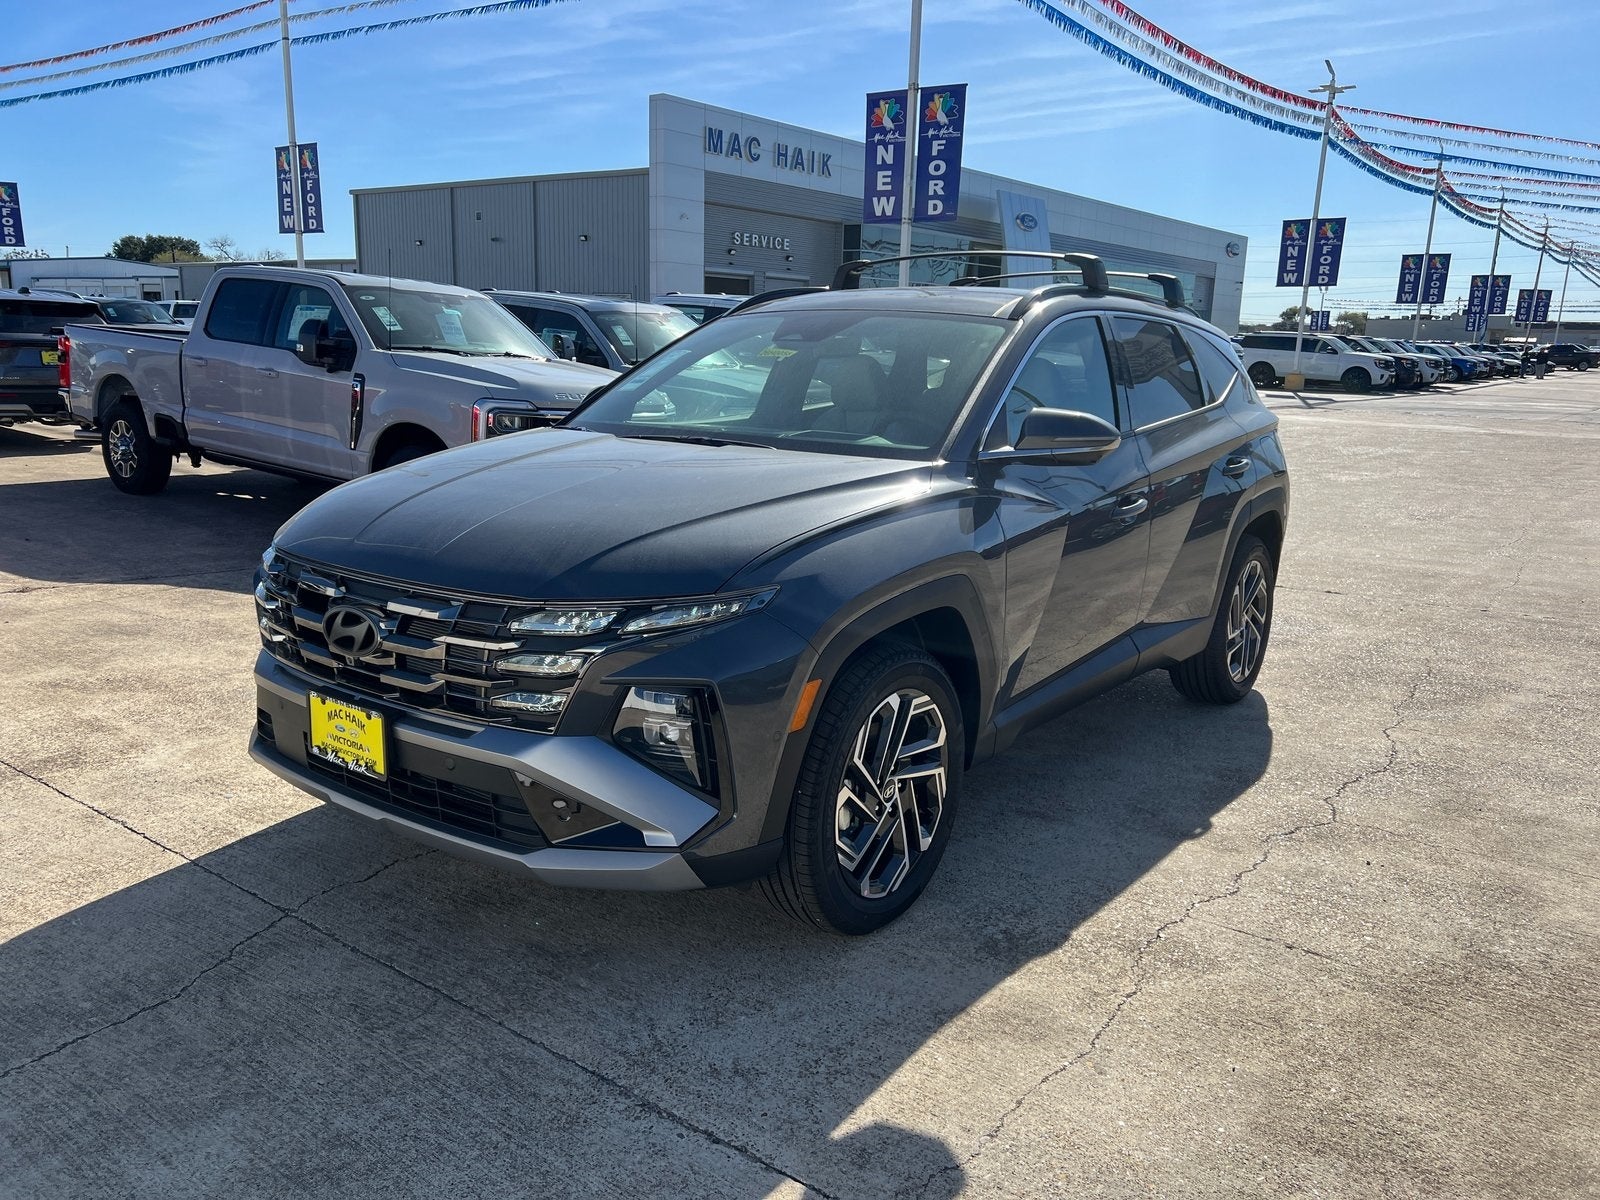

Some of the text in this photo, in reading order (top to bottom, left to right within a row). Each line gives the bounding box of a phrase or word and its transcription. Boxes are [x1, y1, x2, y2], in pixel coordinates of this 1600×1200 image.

[705, 126, 832, 177] MAC HAIK
[872, 144, 896, 217] NEW
[927, 140, 947, 216] FORD
[282, 181, 294, 229] NEW
[306, 180, 317, 230] FORD
[1, 207, 16, 245] FORD
[734, 231, 790, 251] SERVICE
[1283, 246, 1299, 284] NEW
[1317, 245, 1332, 284] FORD
[1401, 273, 1415, 302] NEW
[1428, 273, 1441, 302] FORD
[1471, 290, 1482, 313] NEW
[1493, 289, 1504, 313] FORD
[1518, 302, 1528, 321] NEW
[1536, 302, 1546, 321] FORD
[327, 708, 367, 735] MAC HAIK
[332, 733, 365, 753] VICTORIA
[323, 751, 374, 777] Mac Haik
